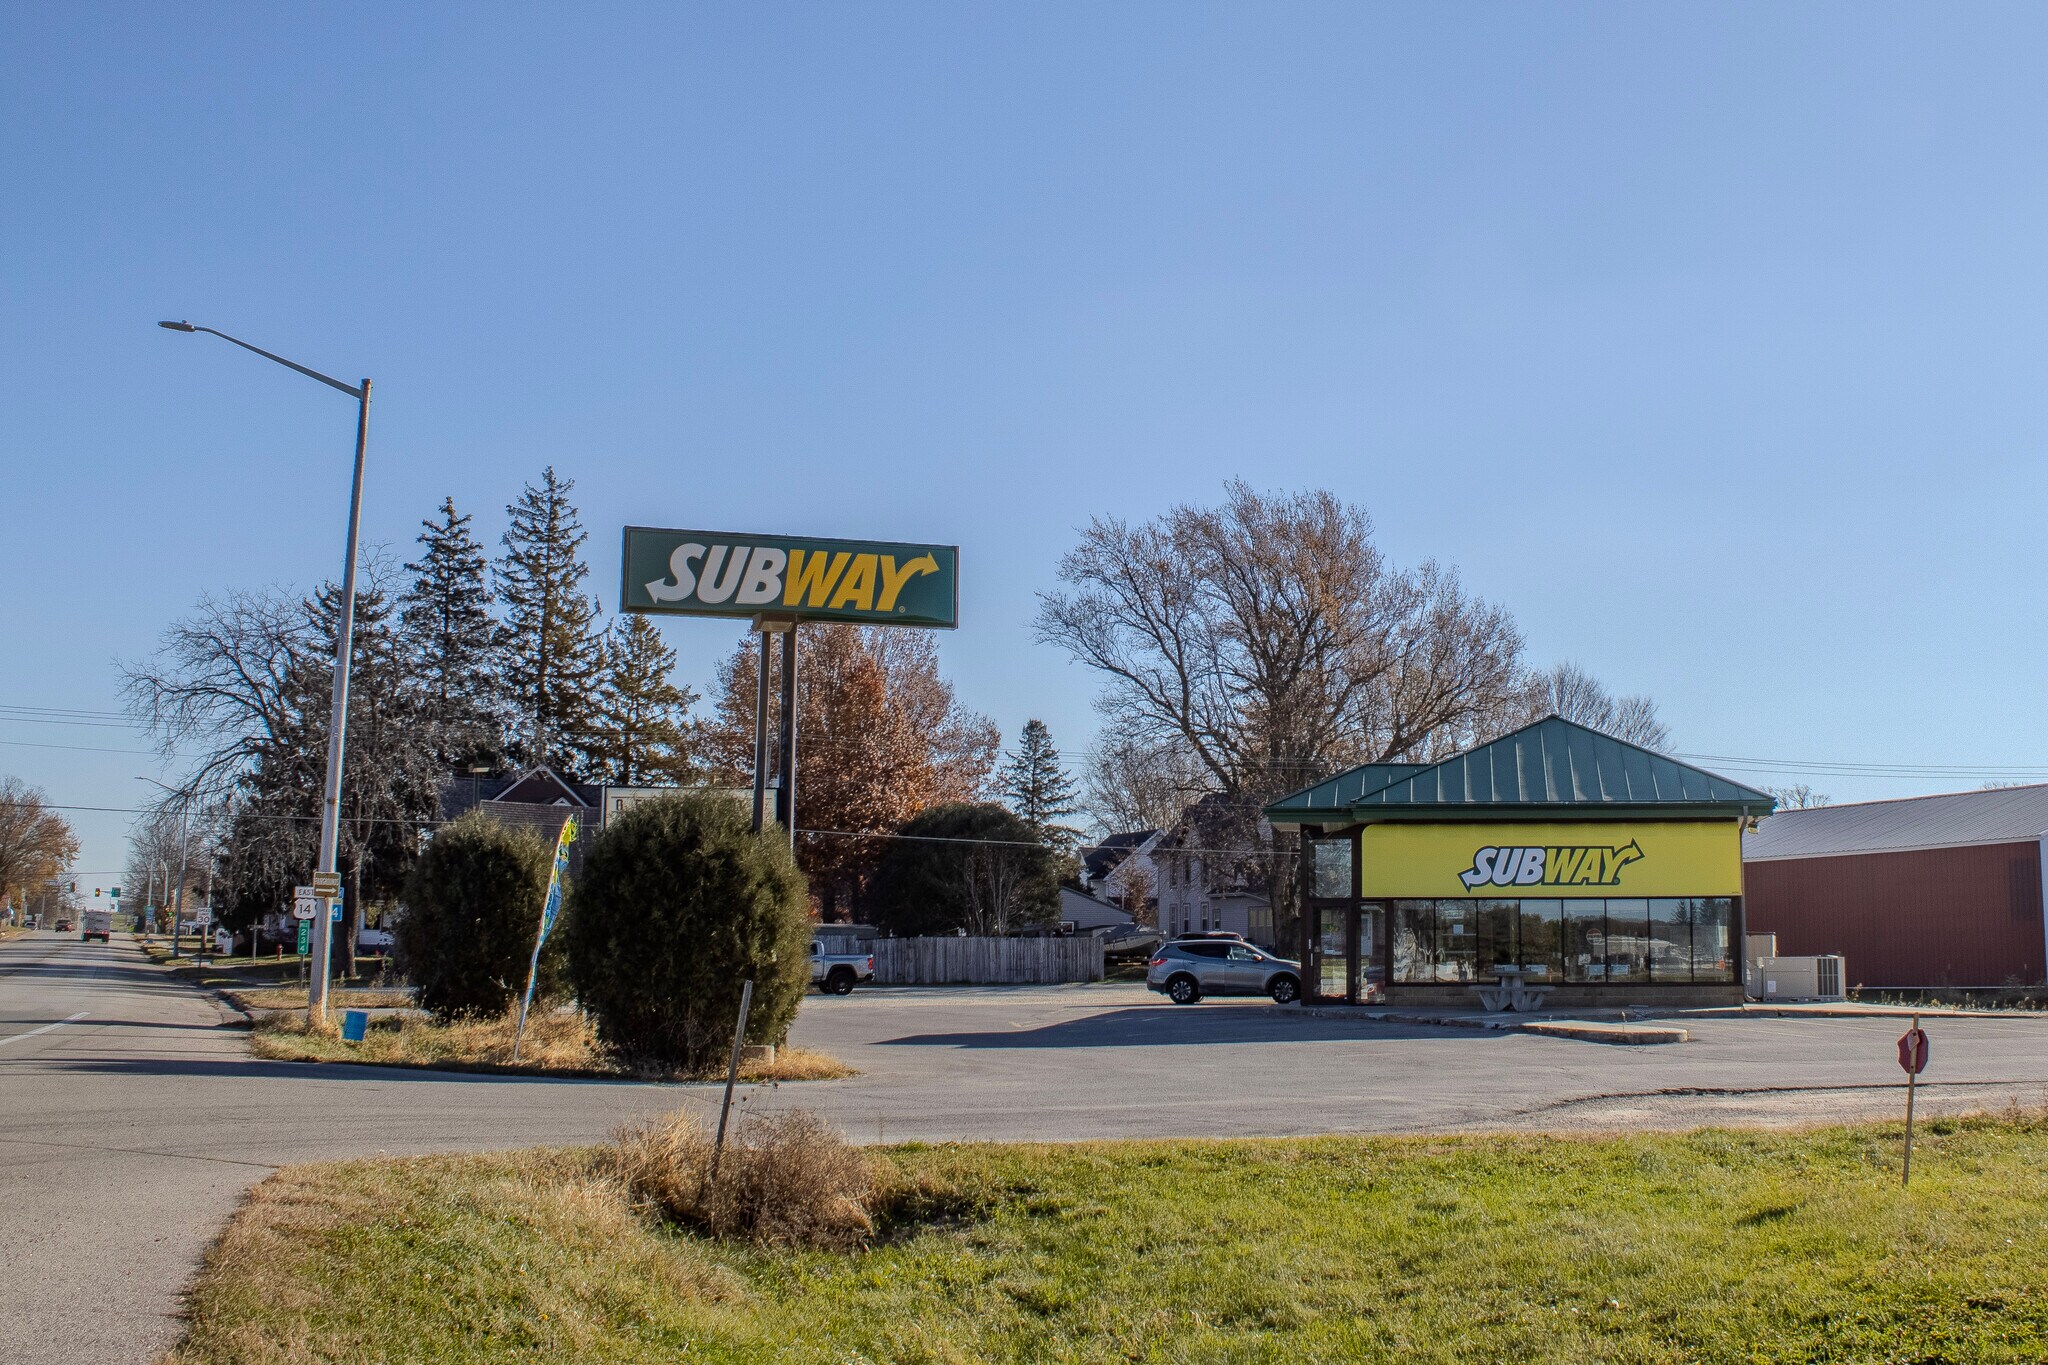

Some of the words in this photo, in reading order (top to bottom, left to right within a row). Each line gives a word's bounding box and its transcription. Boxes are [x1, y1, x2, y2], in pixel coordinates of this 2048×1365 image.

[645, 543, 940, 612] SUBWAY
[1459, 839, 1645, 892] SUBWAY
[299, 904, 312, 914] 14
